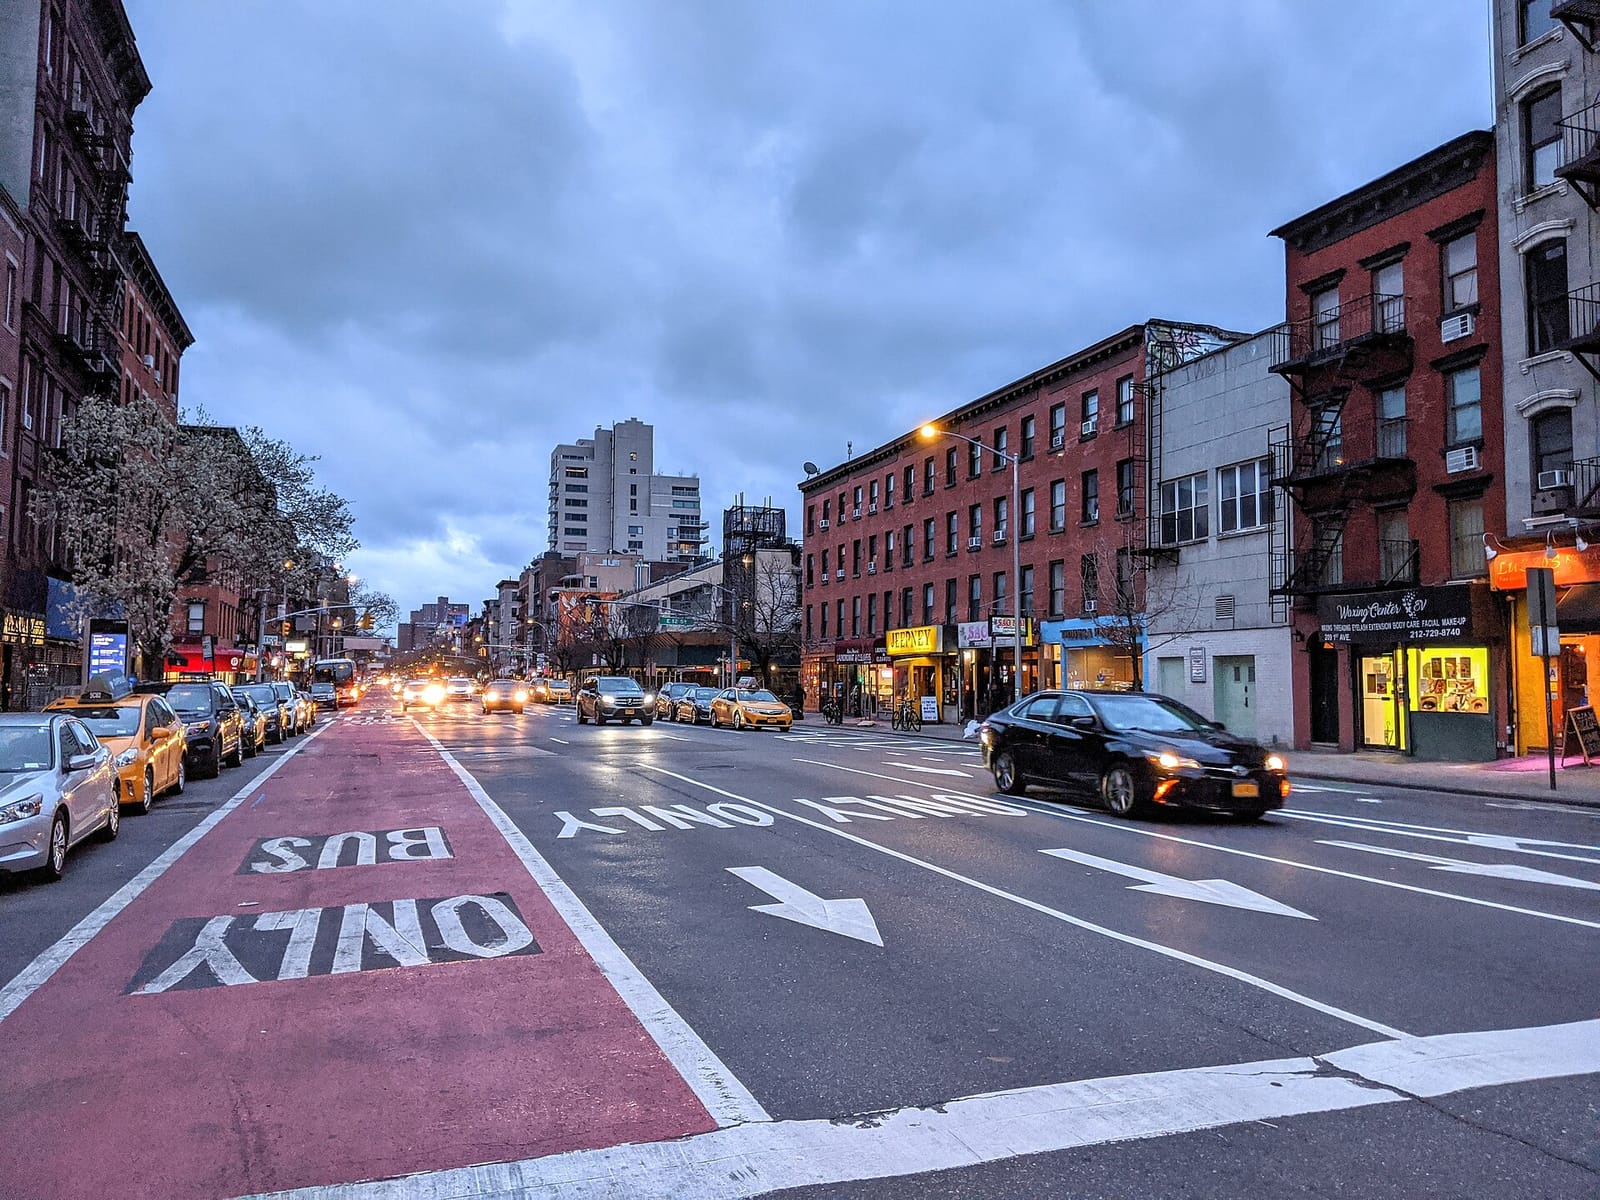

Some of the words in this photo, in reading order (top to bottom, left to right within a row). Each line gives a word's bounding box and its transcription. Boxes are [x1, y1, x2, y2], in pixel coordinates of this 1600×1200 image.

[1336, 604, 1368, 623] Waxing
[1367, 601, 1401, 618] Center
[1368, 621, 1392, 631] EXTENSION
[1392, 621, 1406, 630] BODY
[1406, 620, 1420, 628] CARE
[1421, 618, 1440, 627] FACIAL
[1441, 616, 1467, 626] MAKE-UP
[890, 629, 932, 649] JEEPNEY
[553, 801, 774, 839] ONLY
[793, 795, 1028, 823] ONLY
[250, 826, 452, 874] BUS
[130, 894, 534, 996] ONLY
